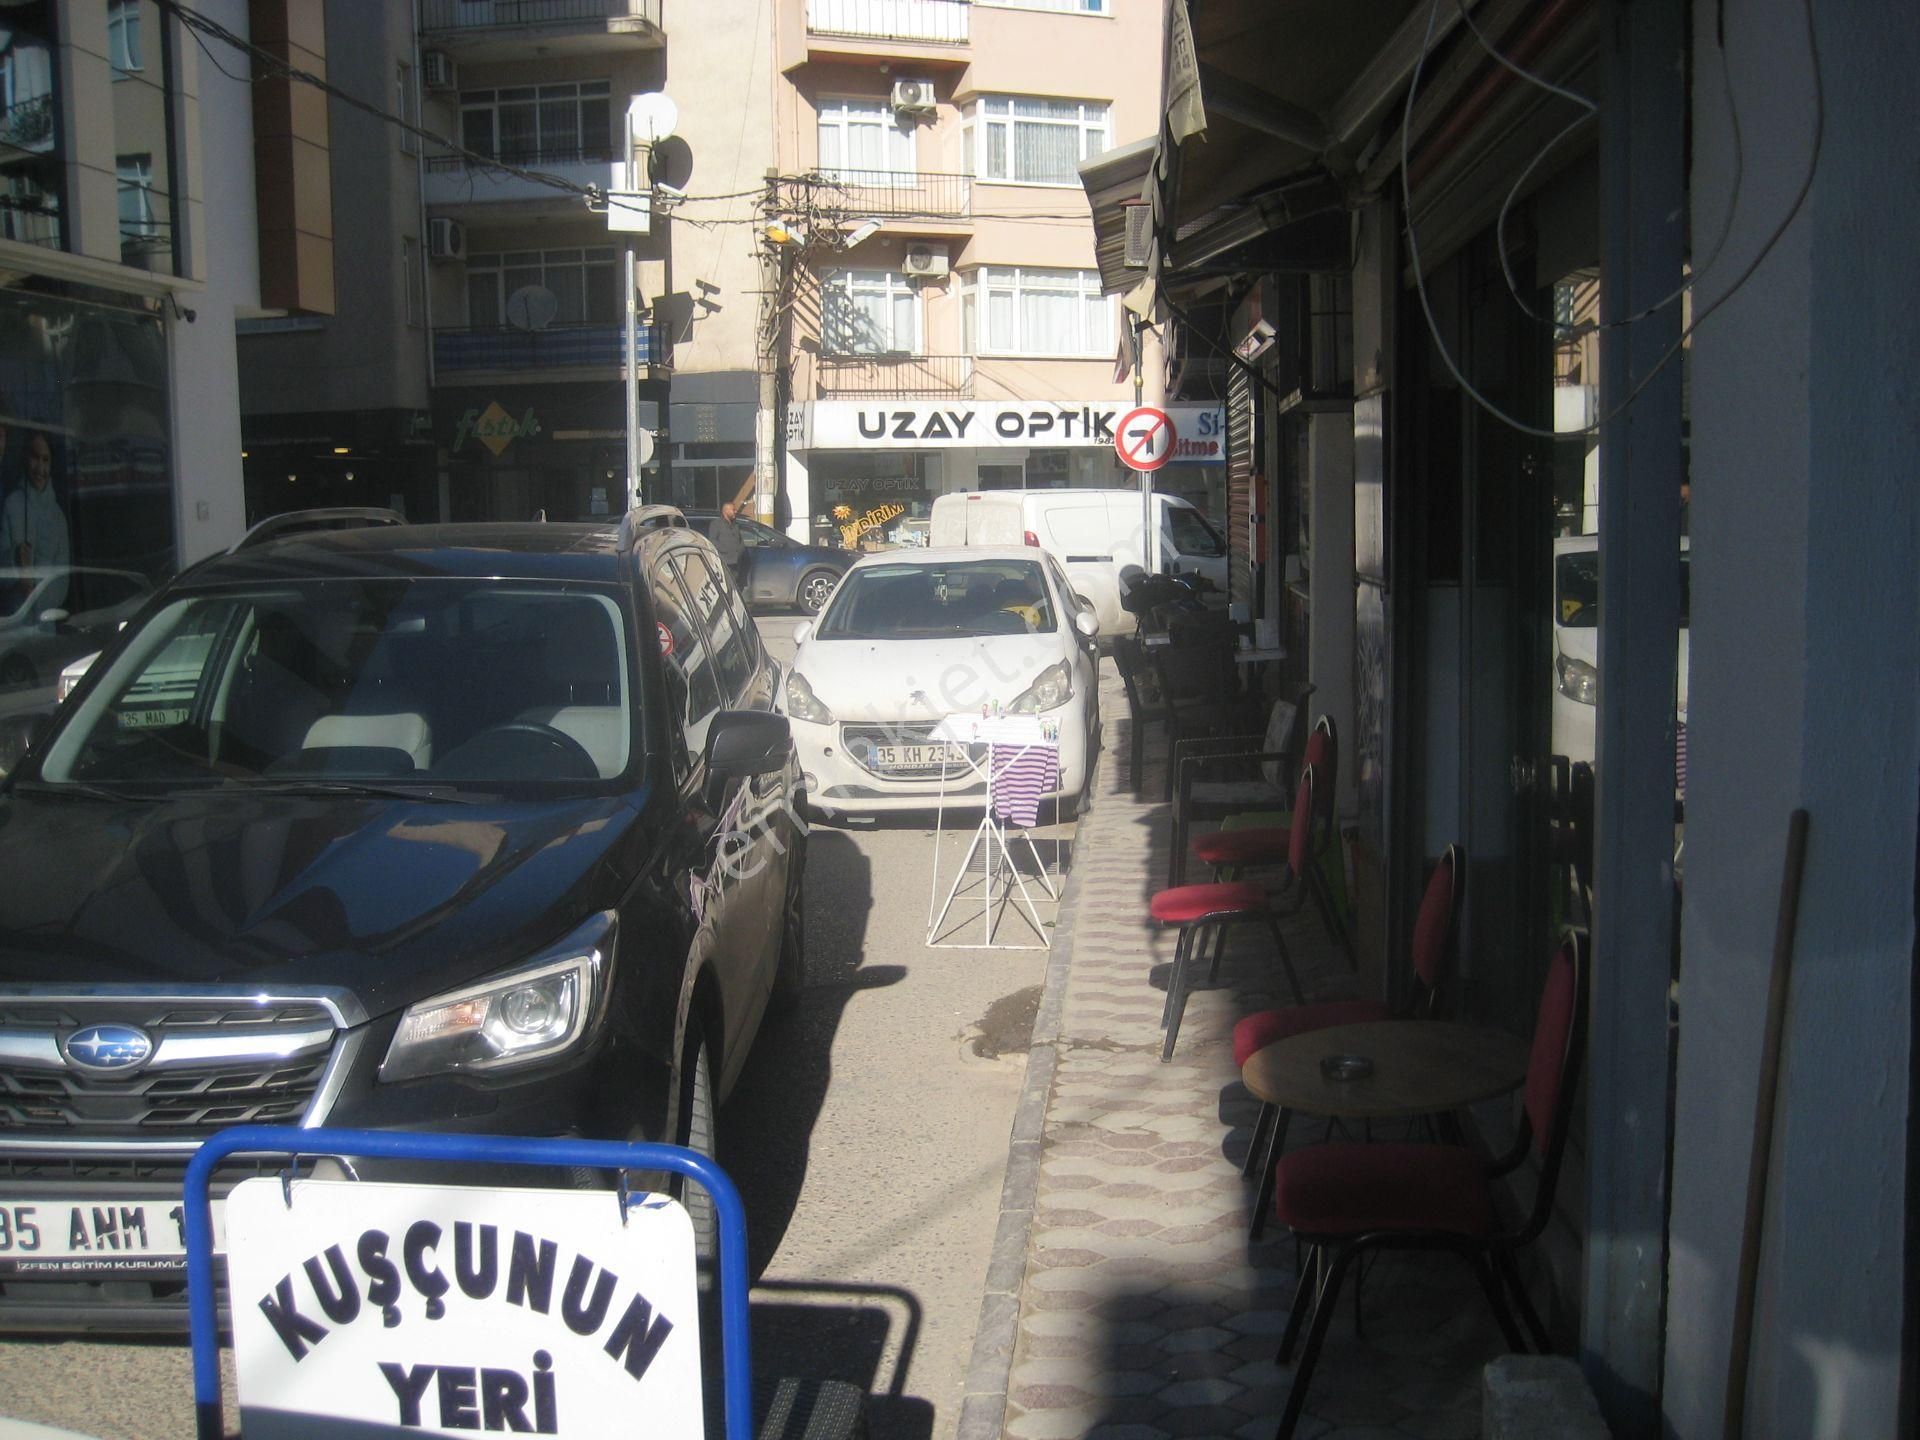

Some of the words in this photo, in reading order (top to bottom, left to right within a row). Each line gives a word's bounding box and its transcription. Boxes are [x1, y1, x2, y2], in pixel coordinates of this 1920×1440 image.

[787, 411, 803, 424] ZAY
[858, 411, 975, 439] UZAY
[995, 407, 1116, 439] OPTİK
[825, 478, 870, 491] UZAY
[878, 747, 896, 763] 35
[903, 746, 922, 763] KH
[69, 1206, 149, 1250] ANM
[258, 1219, 674, 1382] KUŞÇUNUN
[377, 1349, 558, 1435] YERİ
